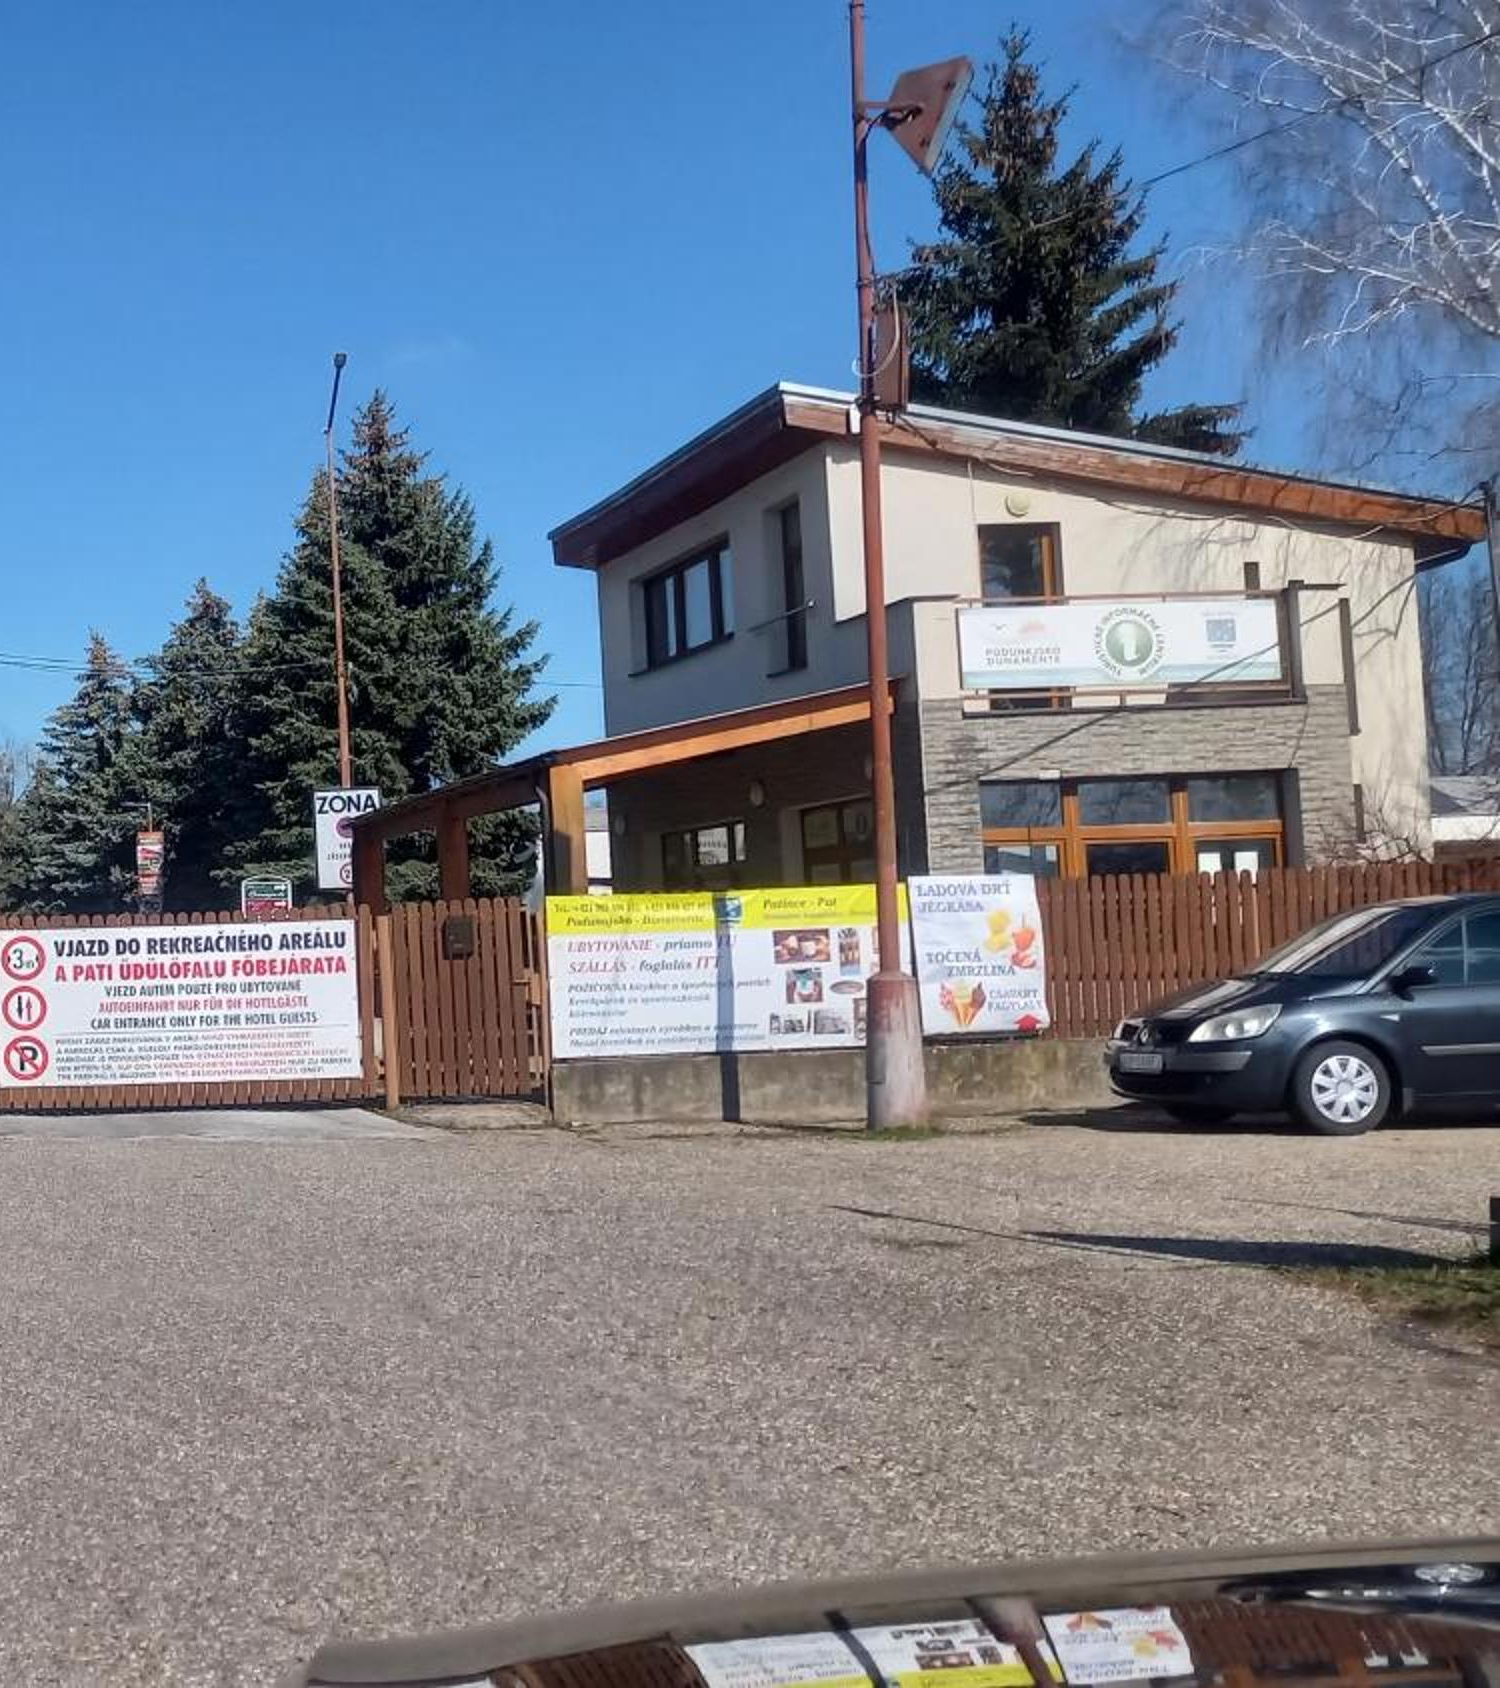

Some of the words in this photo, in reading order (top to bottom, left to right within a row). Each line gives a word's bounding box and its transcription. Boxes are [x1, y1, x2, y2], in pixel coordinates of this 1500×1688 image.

[316, 793, 377, 814] ZONA
[54, 939, 110, 957] VJAZD
[115, 938, 141, 956] DO
[146, 930, 273, 955] REKREAČNÉHO
[279, 927, 347, 950] AREÁLU
[55, 965, 67, 982] A
[73, 964, 113, 981] PATI
[946, 964, 1016, 978] ZMRZLINA
[104, 985, 137, 997] VJEZD
[139, 984, 175, 996] AUTEM
[178, 982, 213, 995] POUZE
[215, 982, 237, 994] PRO
[178, 1000, 201, 1012] NUR
[91, 1019, 111, 1030] CAR
[114, 1017, 167, 1029] ENTRANCE
[169, 1016, 198, 1028] ONLY
[200, 1014, 222, 1027] FOR
[224, 1014, 242, 1026] THE
[245, 1012, 277, 1025] HOTEL
[279, 1011, 318, 1023] GUESTS
